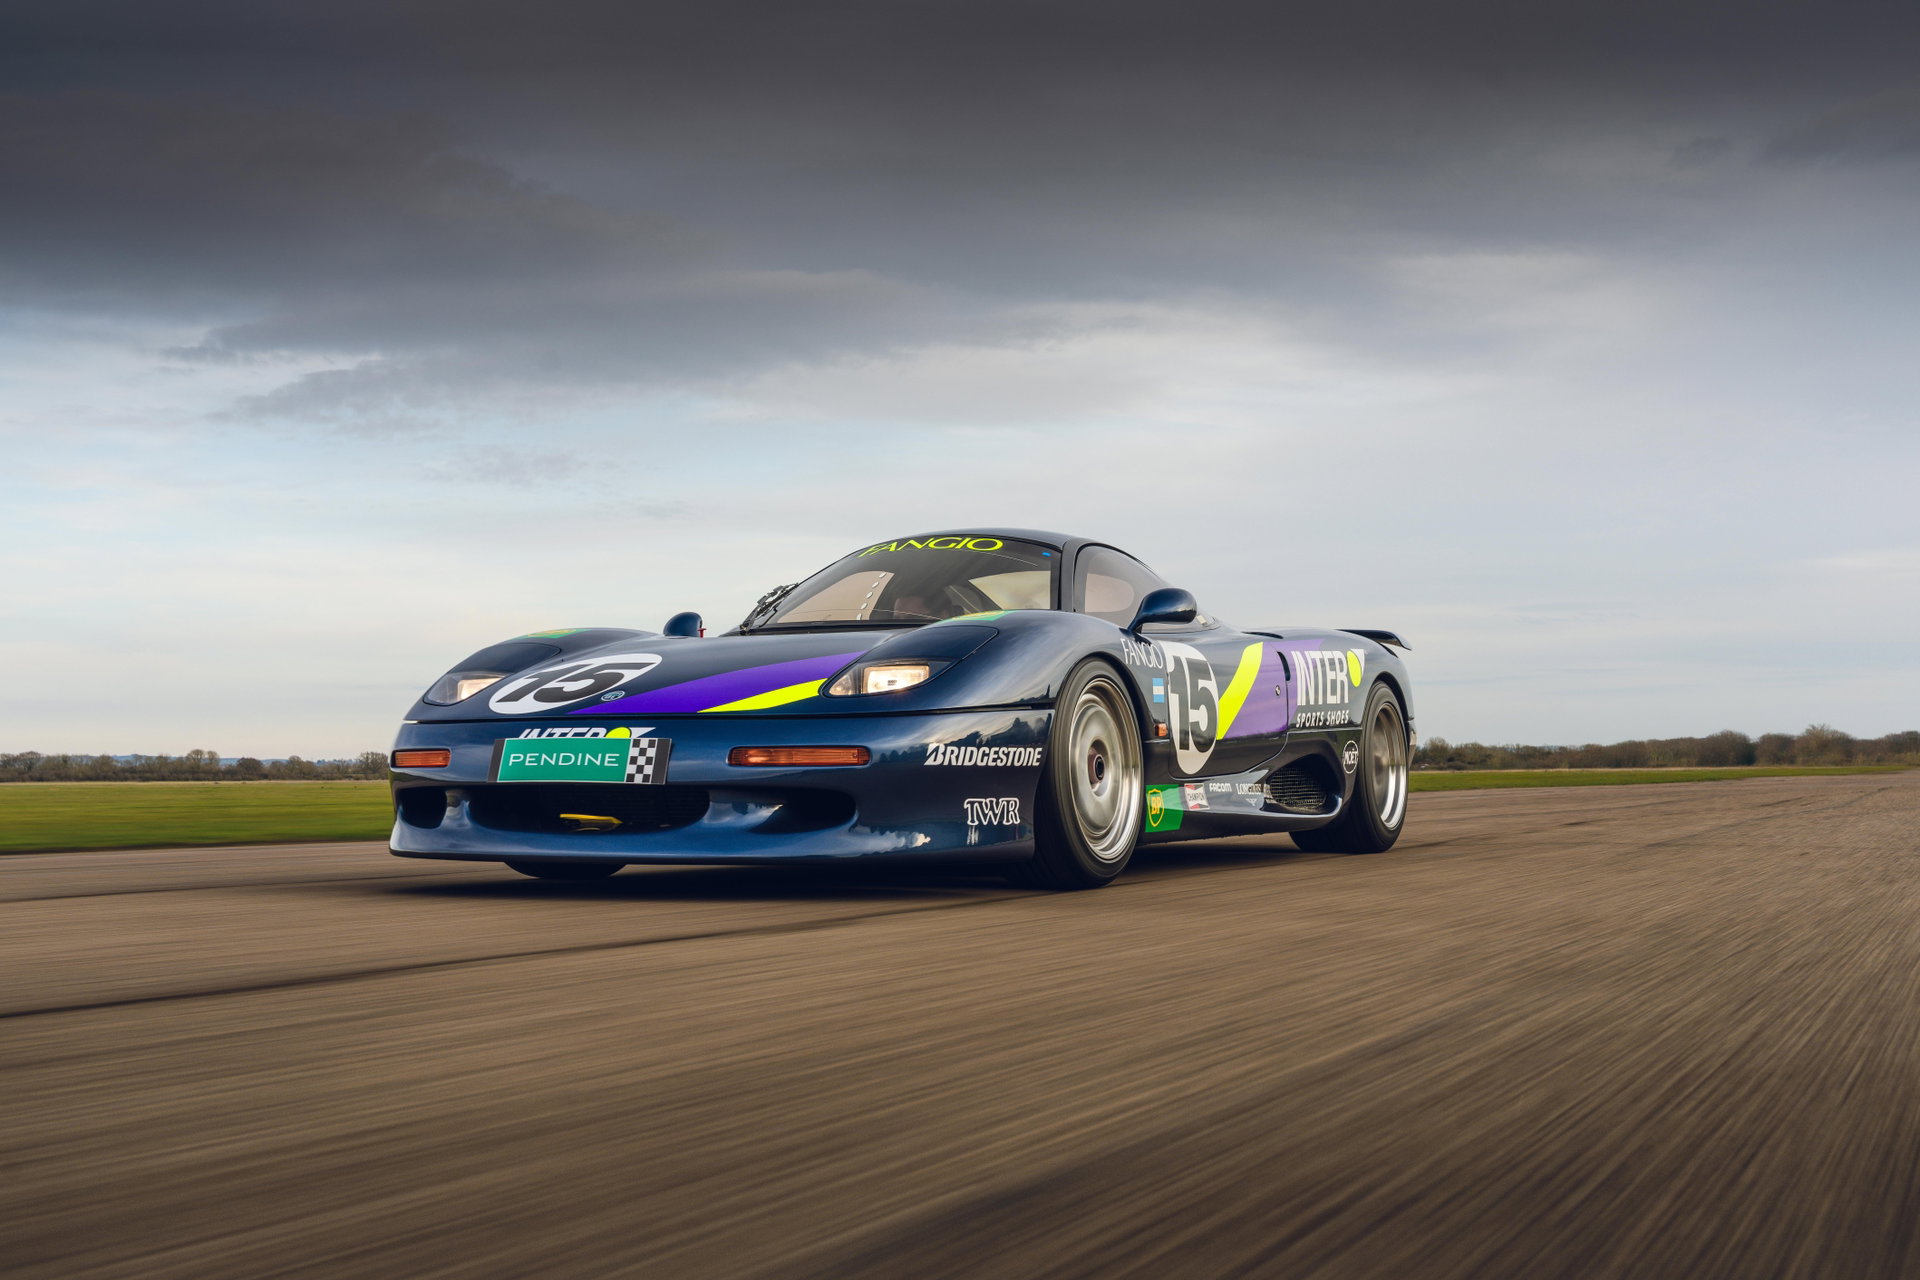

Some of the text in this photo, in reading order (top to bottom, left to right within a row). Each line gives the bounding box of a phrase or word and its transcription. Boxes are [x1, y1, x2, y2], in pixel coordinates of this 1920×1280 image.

[858, 537, 1003, 557] FANGIO
[1121, 639, 1164, 669] FANGIO
[496, 663, 656, 703] 15
[1291, 651, 1349, 705] INTER
[1169, 655, 1217, 752] 15
[1296, 710, 1349, 728] SPORTS SHOES
[509, 753, 620, 766] PENDINE
[924, 743, 1042, 766] BRIDGESTONE
[964, 798, 1020, 825] TWR
[1151, 796, 1161, 814] BP
